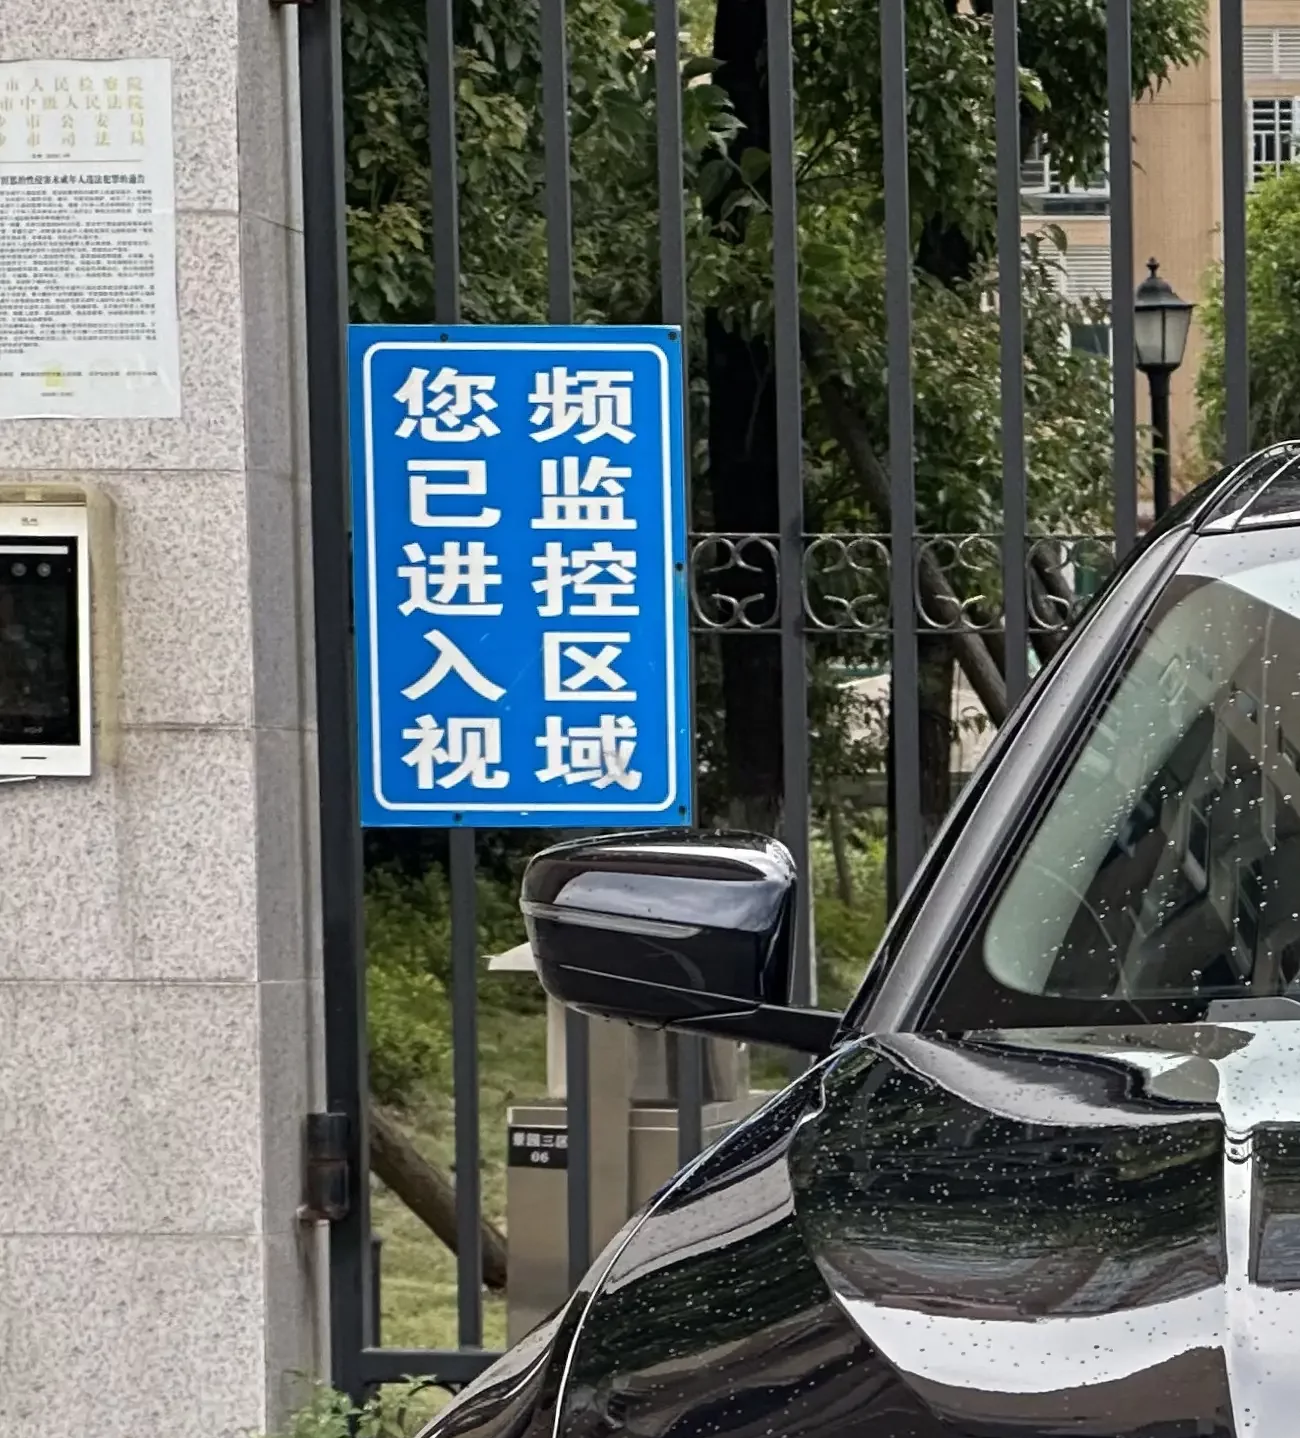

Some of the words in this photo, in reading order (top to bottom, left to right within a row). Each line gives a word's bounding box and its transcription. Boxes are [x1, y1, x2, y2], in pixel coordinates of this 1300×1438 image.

[393, 366, 511, 790] 您已进入视
[528, 365, 643, 791] 频监控区域
